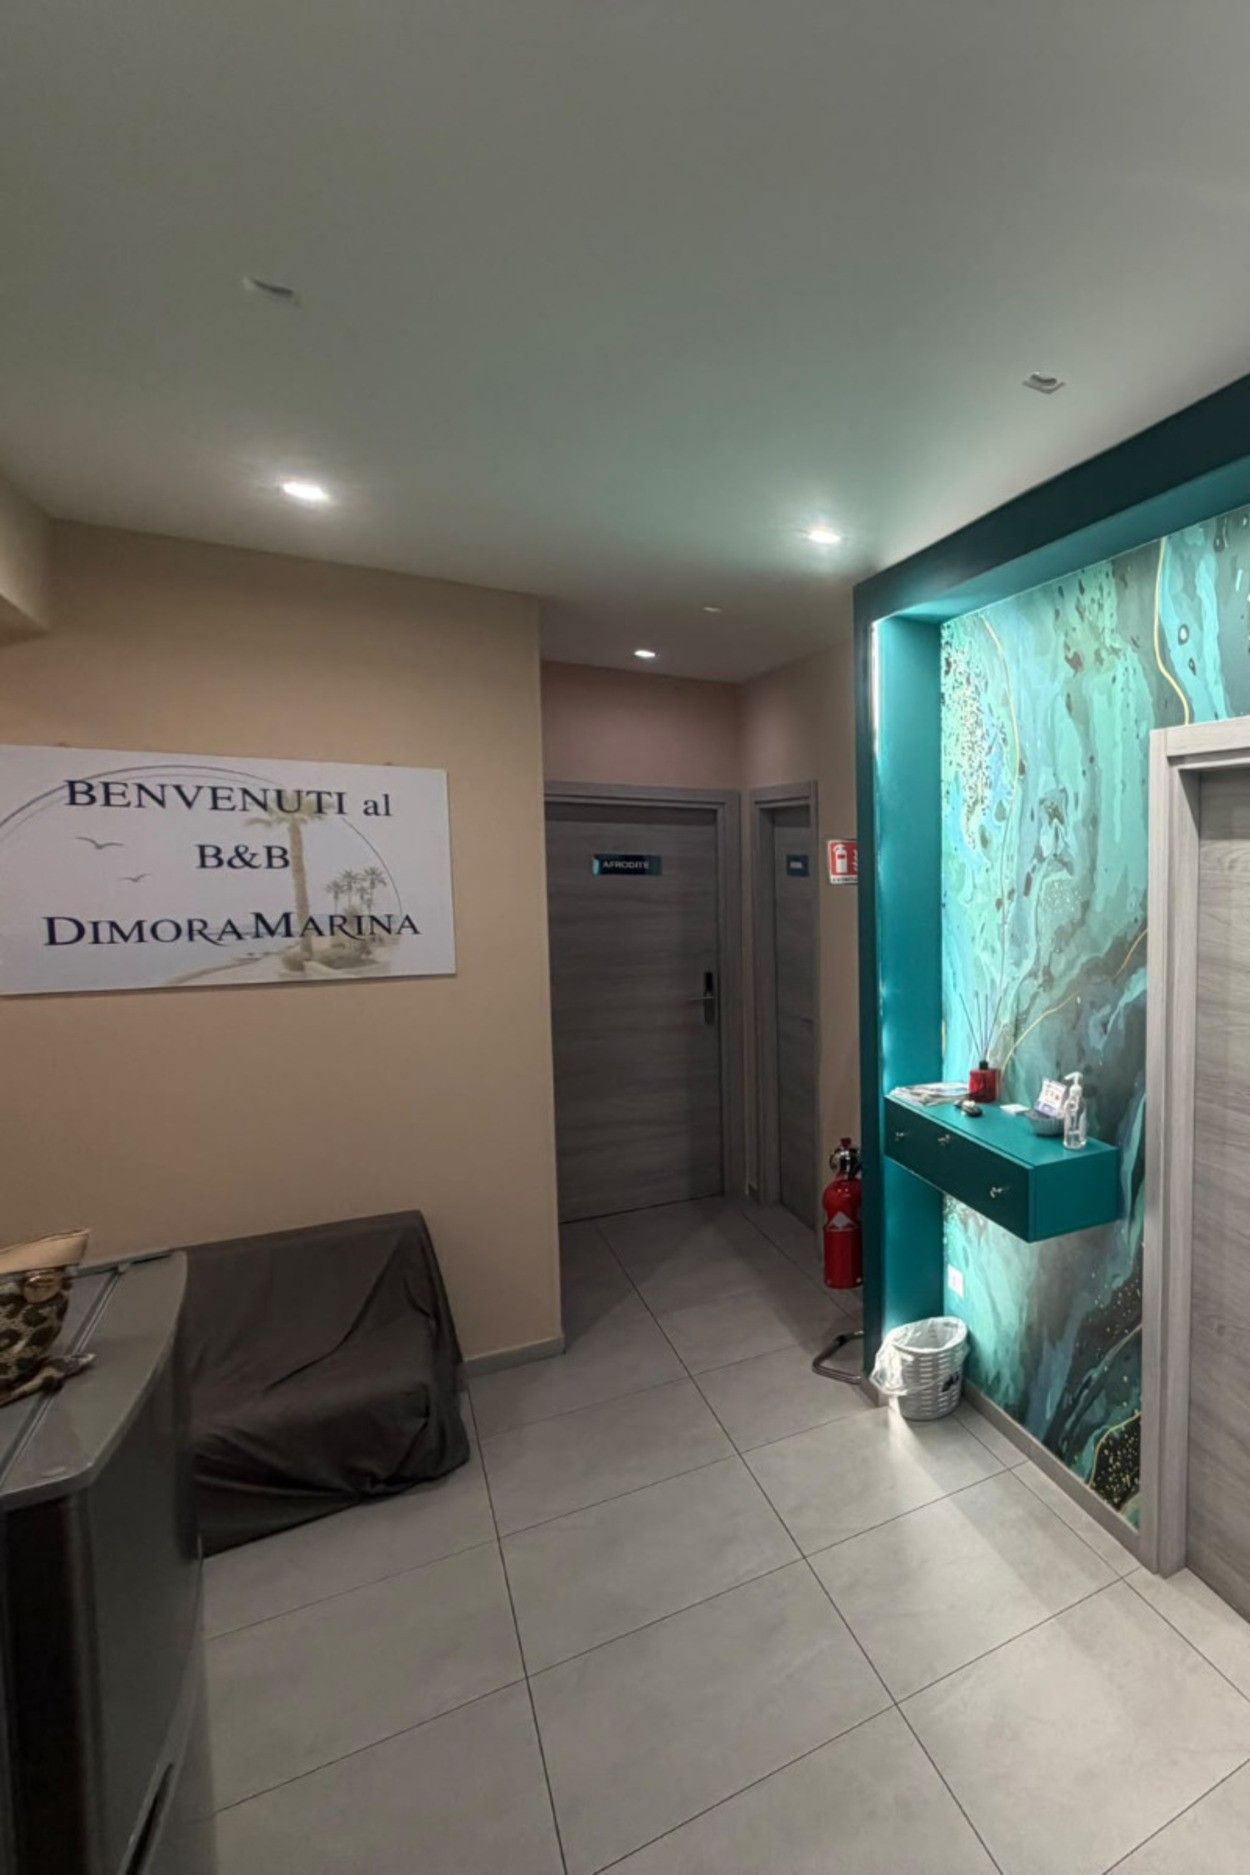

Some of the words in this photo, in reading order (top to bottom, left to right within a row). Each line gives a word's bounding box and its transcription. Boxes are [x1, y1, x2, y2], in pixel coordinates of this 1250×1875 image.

[65, 779, 346, 815] BENVENUTI
[362, 793, 392, 816] al
[196, 844, 291, 870] B&B
[602, 859, 650, 869] AFRODITE
